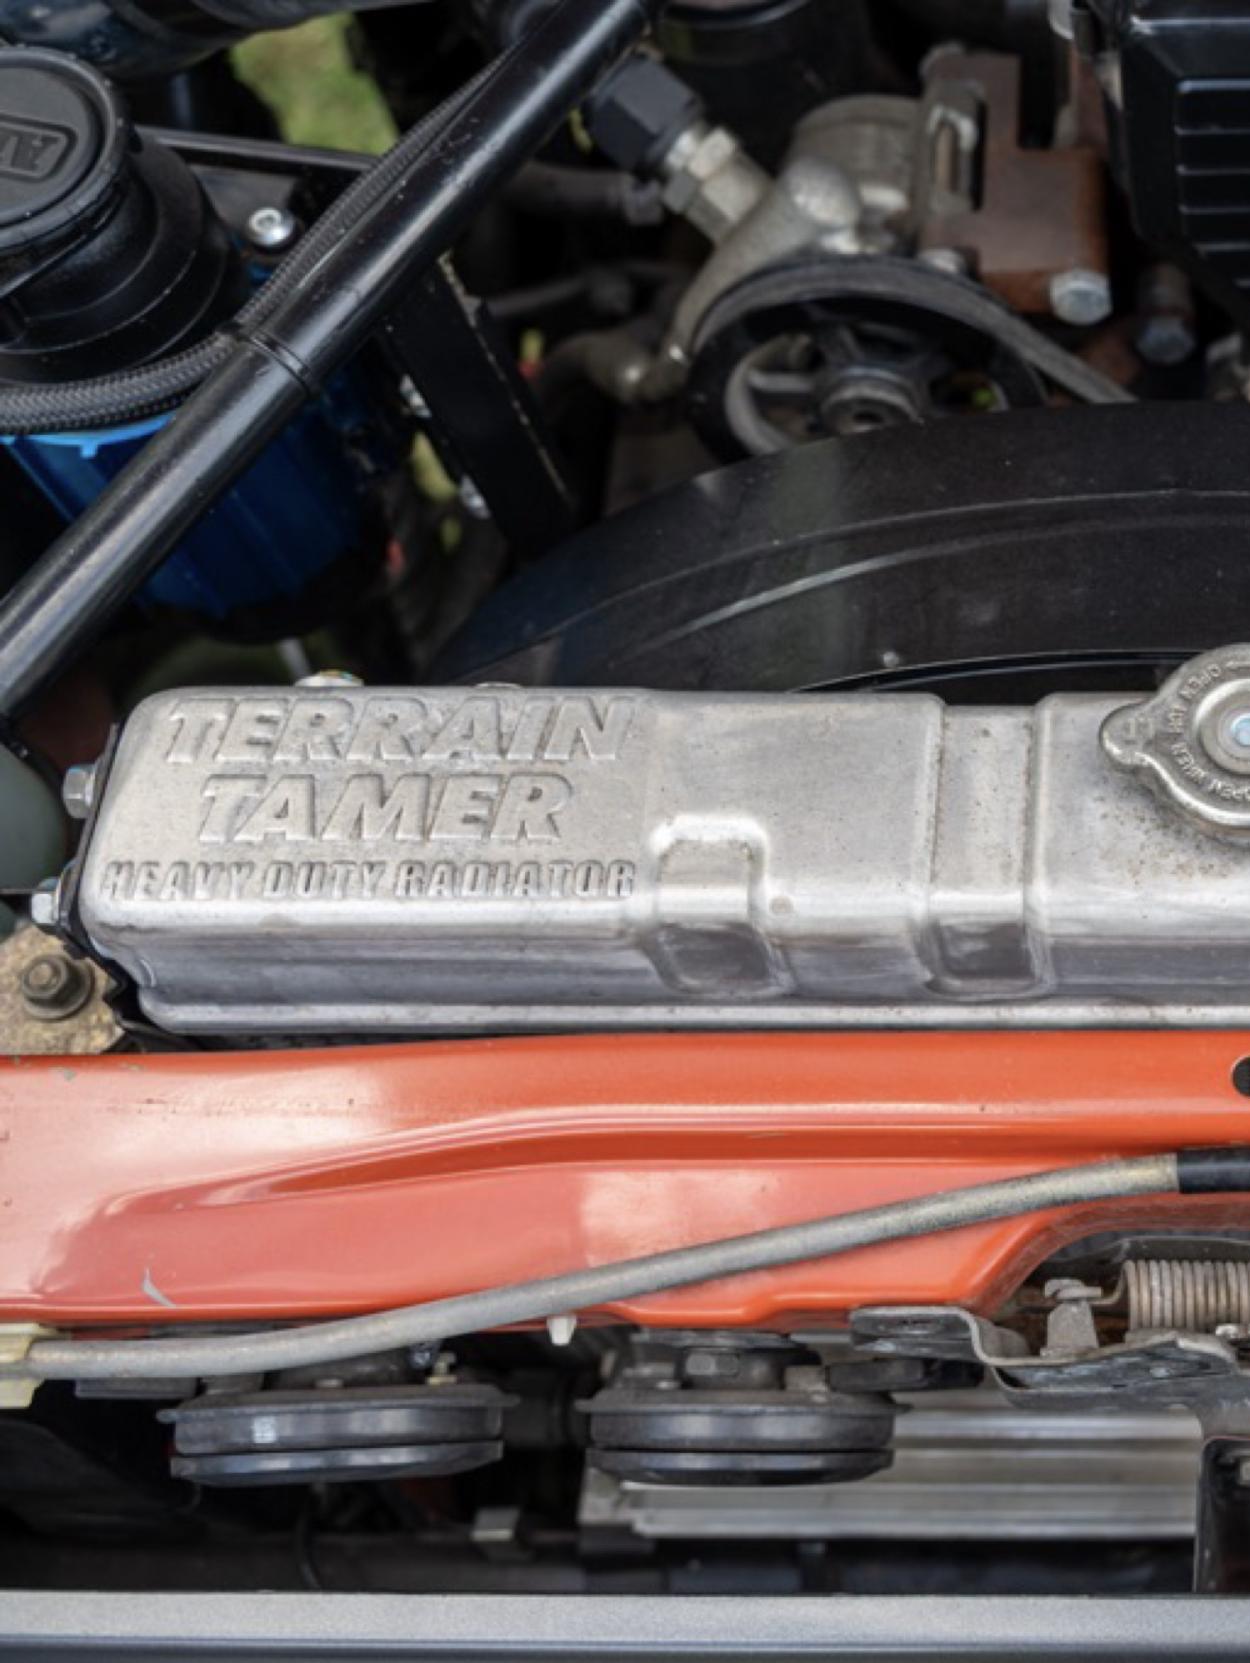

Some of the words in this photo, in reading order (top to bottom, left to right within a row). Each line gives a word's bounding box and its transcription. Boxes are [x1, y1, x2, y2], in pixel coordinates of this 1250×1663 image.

[165, 696, 636, 763] TERRAIN
[198, 770, 573, 844] TAMER
[102, 860, 254, 901] HEAVY
[263, 860, 386, 900] DUTY
[395, 859, 636, 899] RADIATOR
